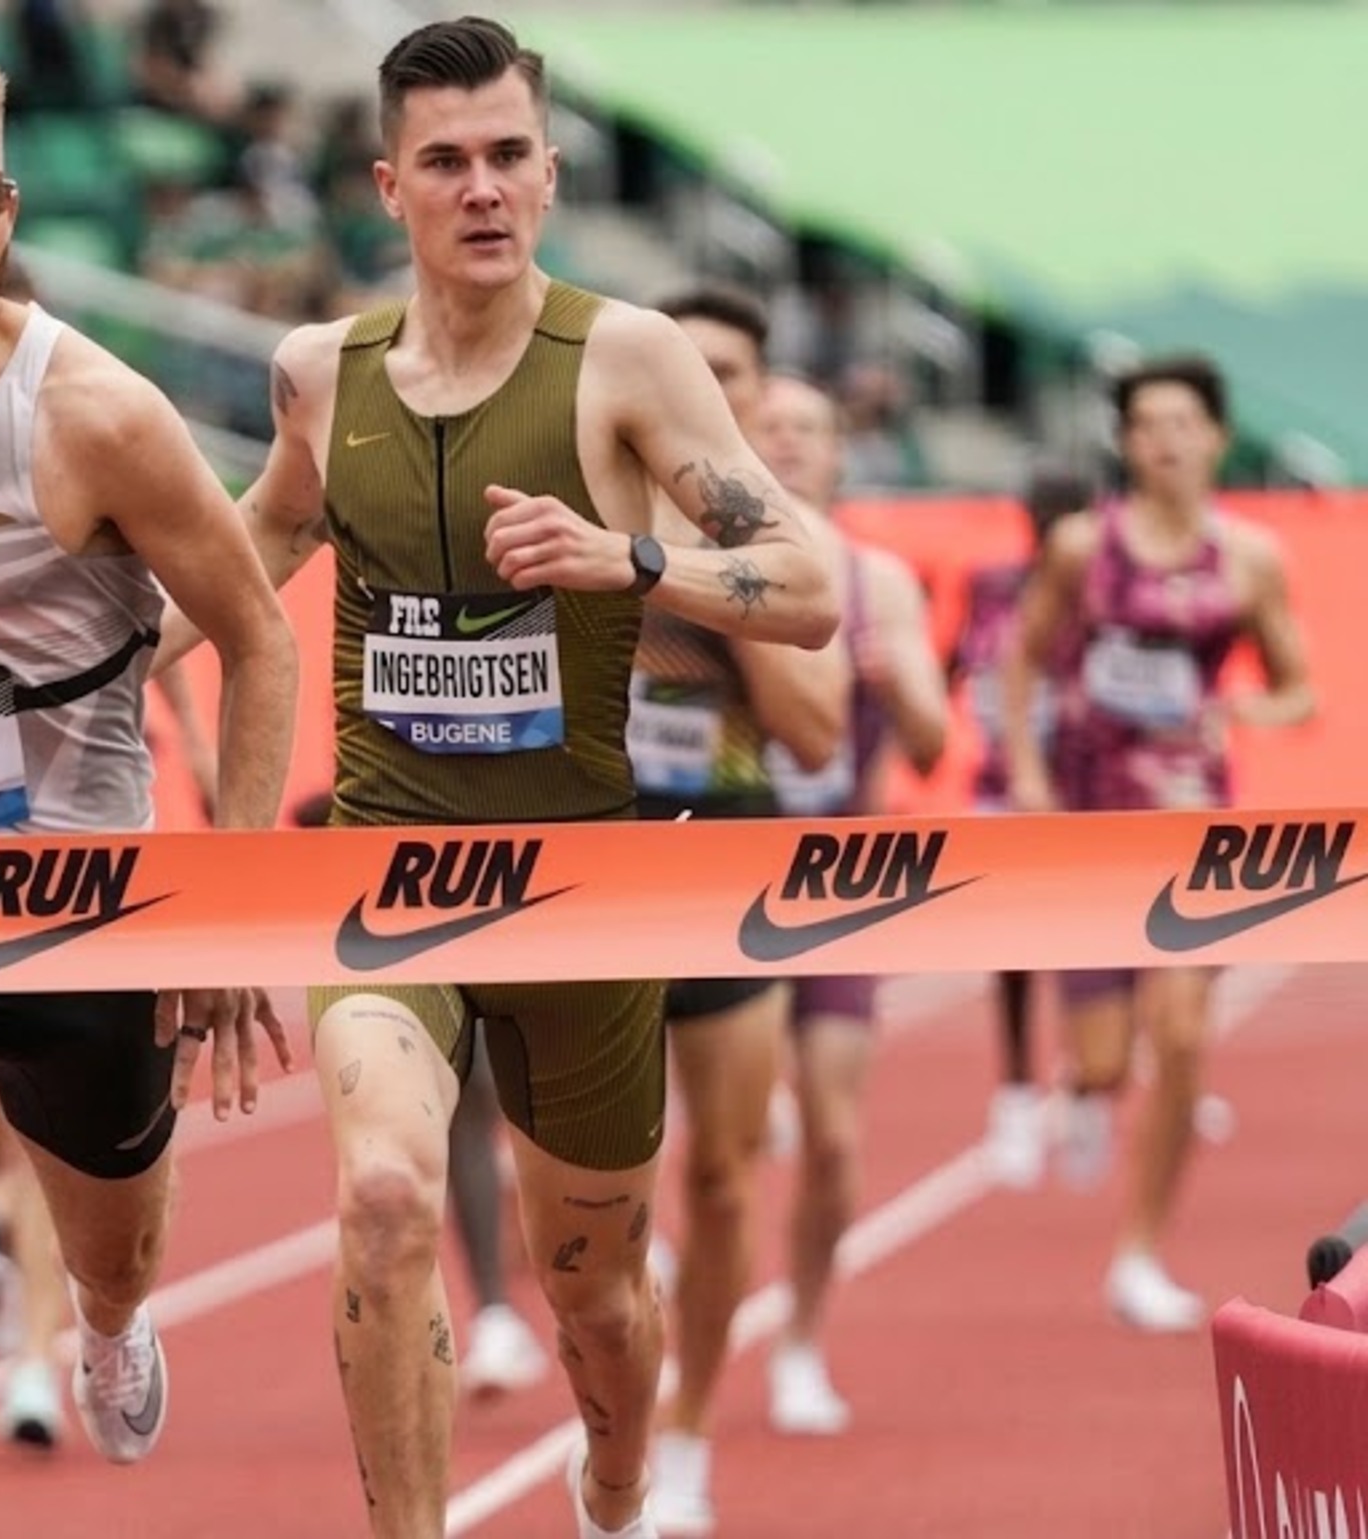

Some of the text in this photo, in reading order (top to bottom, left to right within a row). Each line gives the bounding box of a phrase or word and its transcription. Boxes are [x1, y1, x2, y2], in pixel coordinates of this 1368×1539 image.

[372, 649, 549, 698] INGEBRIGTSEN
[375, 839, 543, 909] RUN
[780, 831, 948, 900] RUN
[1185, 821, 1357, 891] RUN
